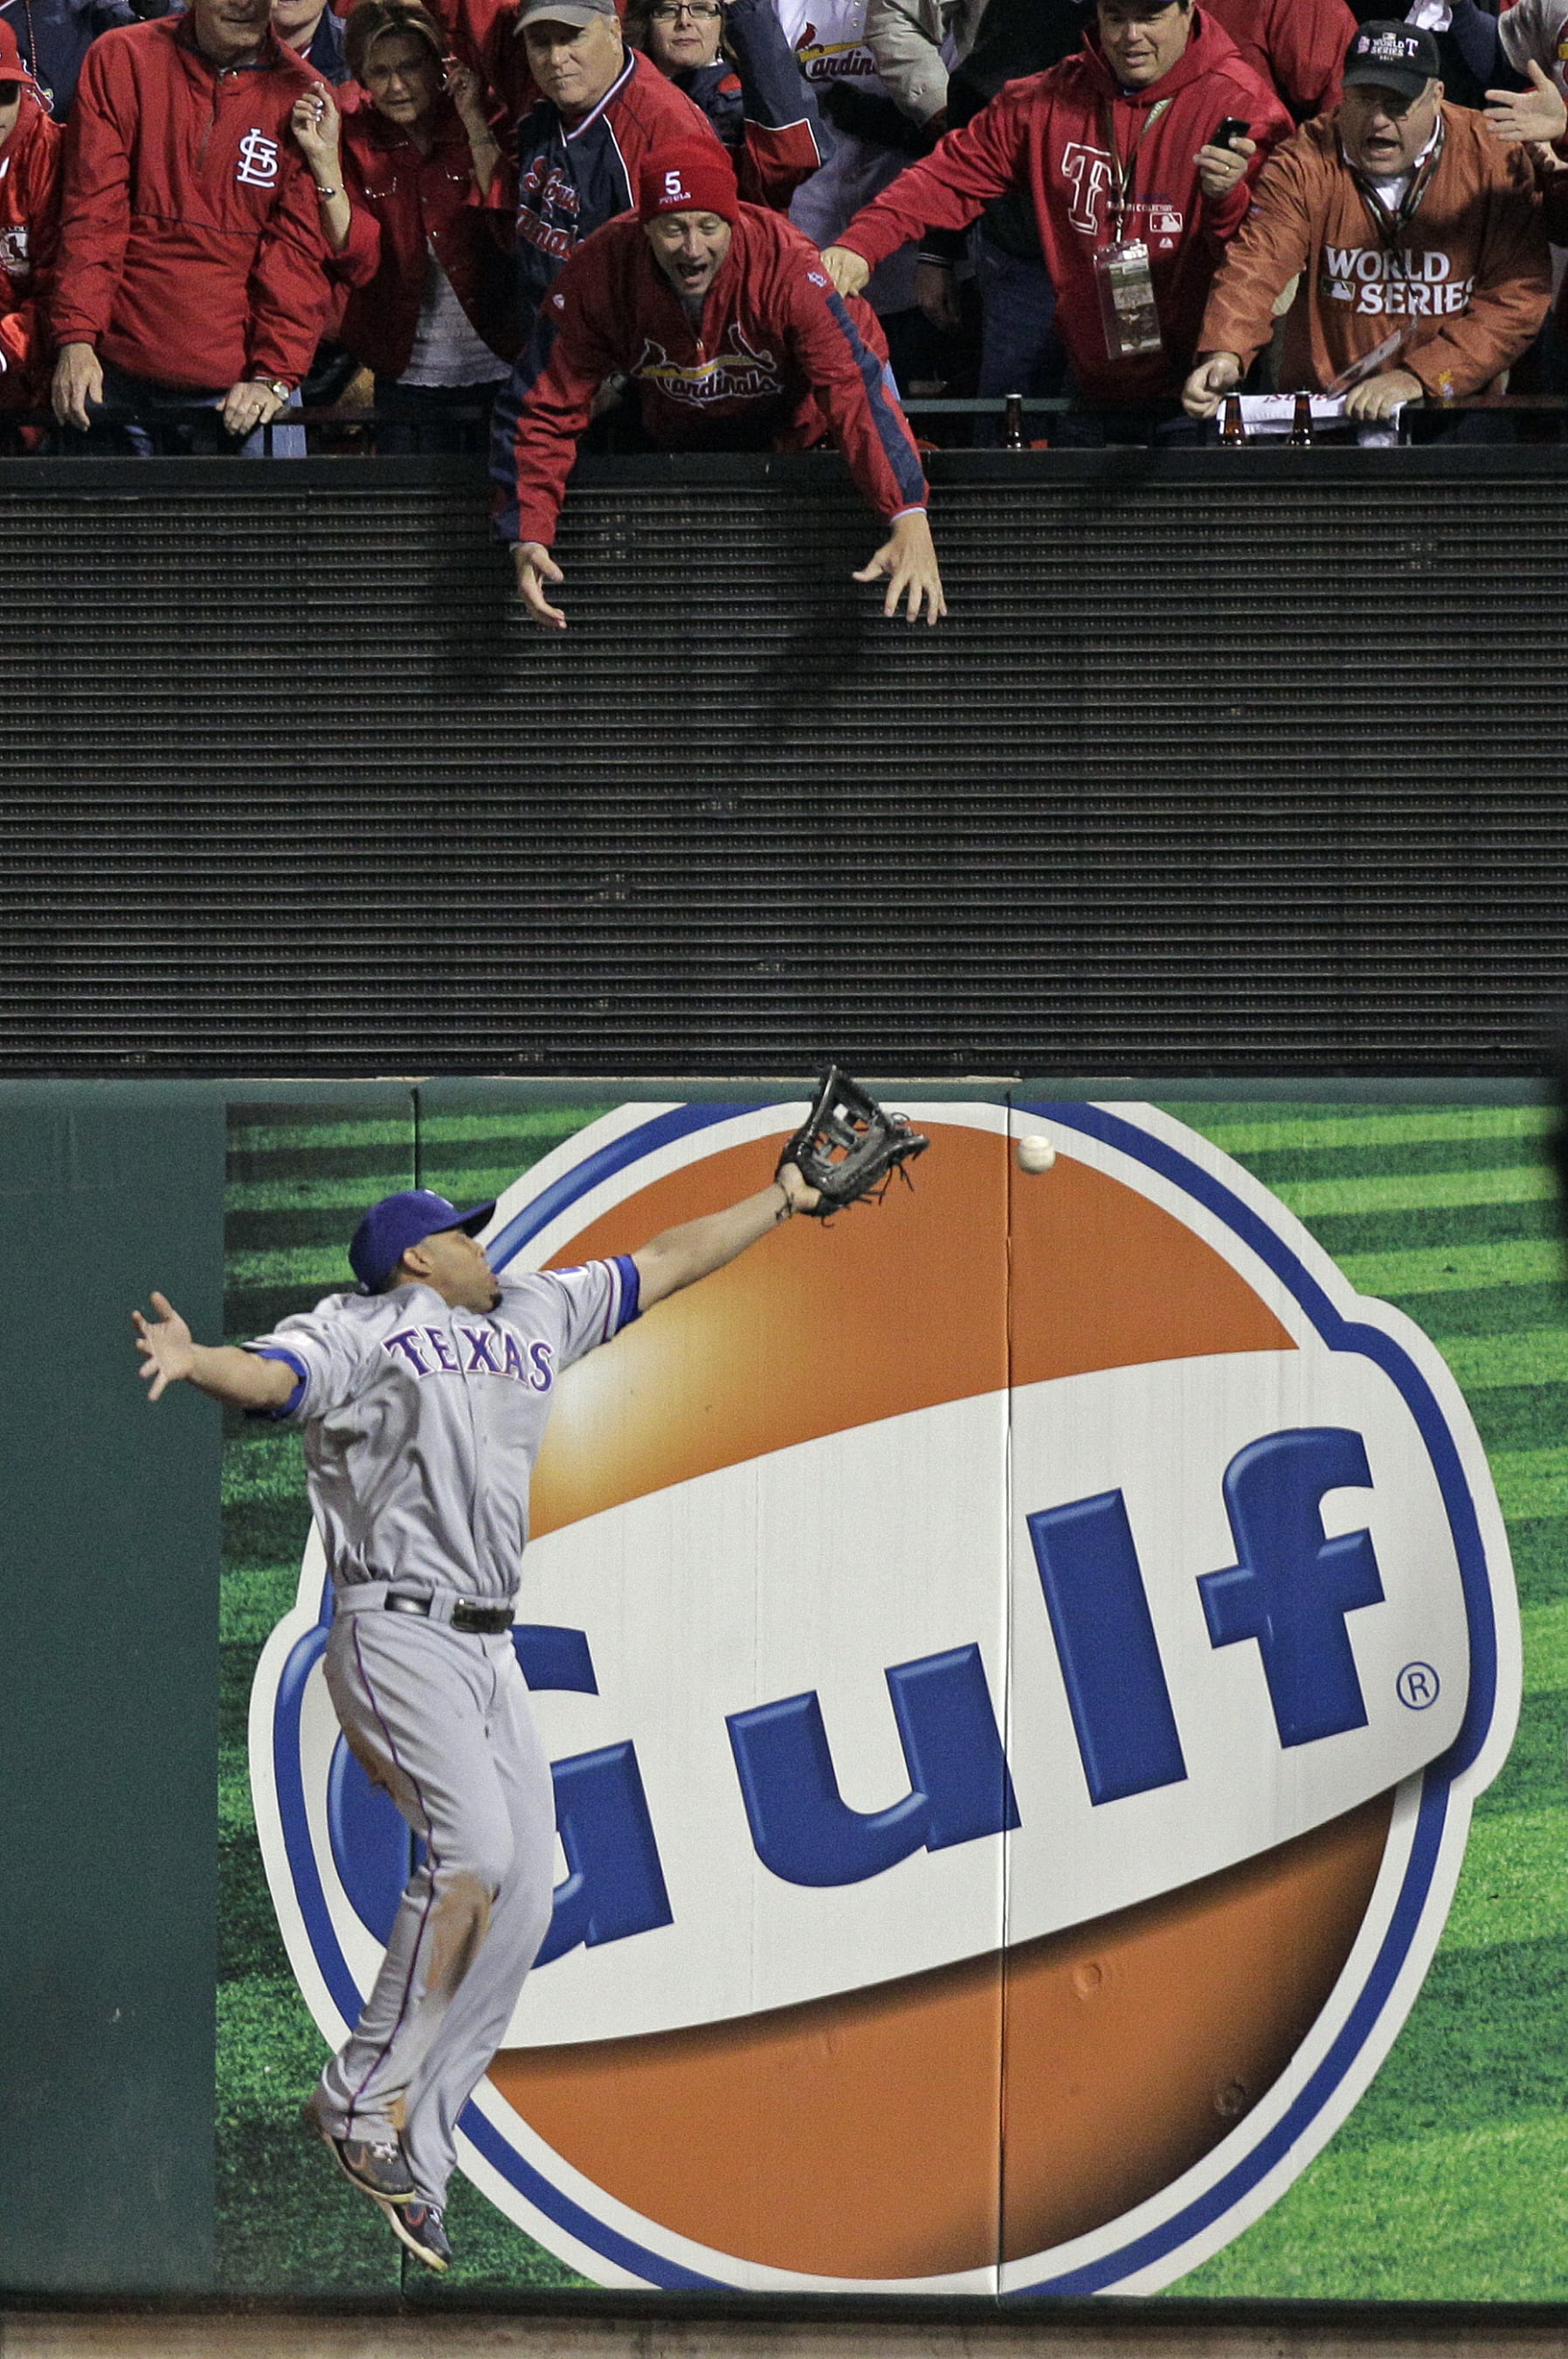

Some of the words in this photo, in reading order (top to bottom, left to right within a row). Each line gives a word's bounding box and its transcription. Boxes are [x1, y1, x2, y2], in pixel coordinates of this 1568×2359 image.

[1371, 46, 1405, 57] SERIES
[1372, 38, 1406, 49] WORLD
[1406, 38, 1419, 57] T
[797, 49, 875, 82] Cardin
[665, 170, 681, 195] 5
[1061, 142, 1114, 236] T
[1324, 245, 1451, 282] WORLD
[656, 367, 786, 410] Cardinals
[381, 1325, 555, 1394] TEXAS
[327, 1426, 1386, 1972] Gulf
